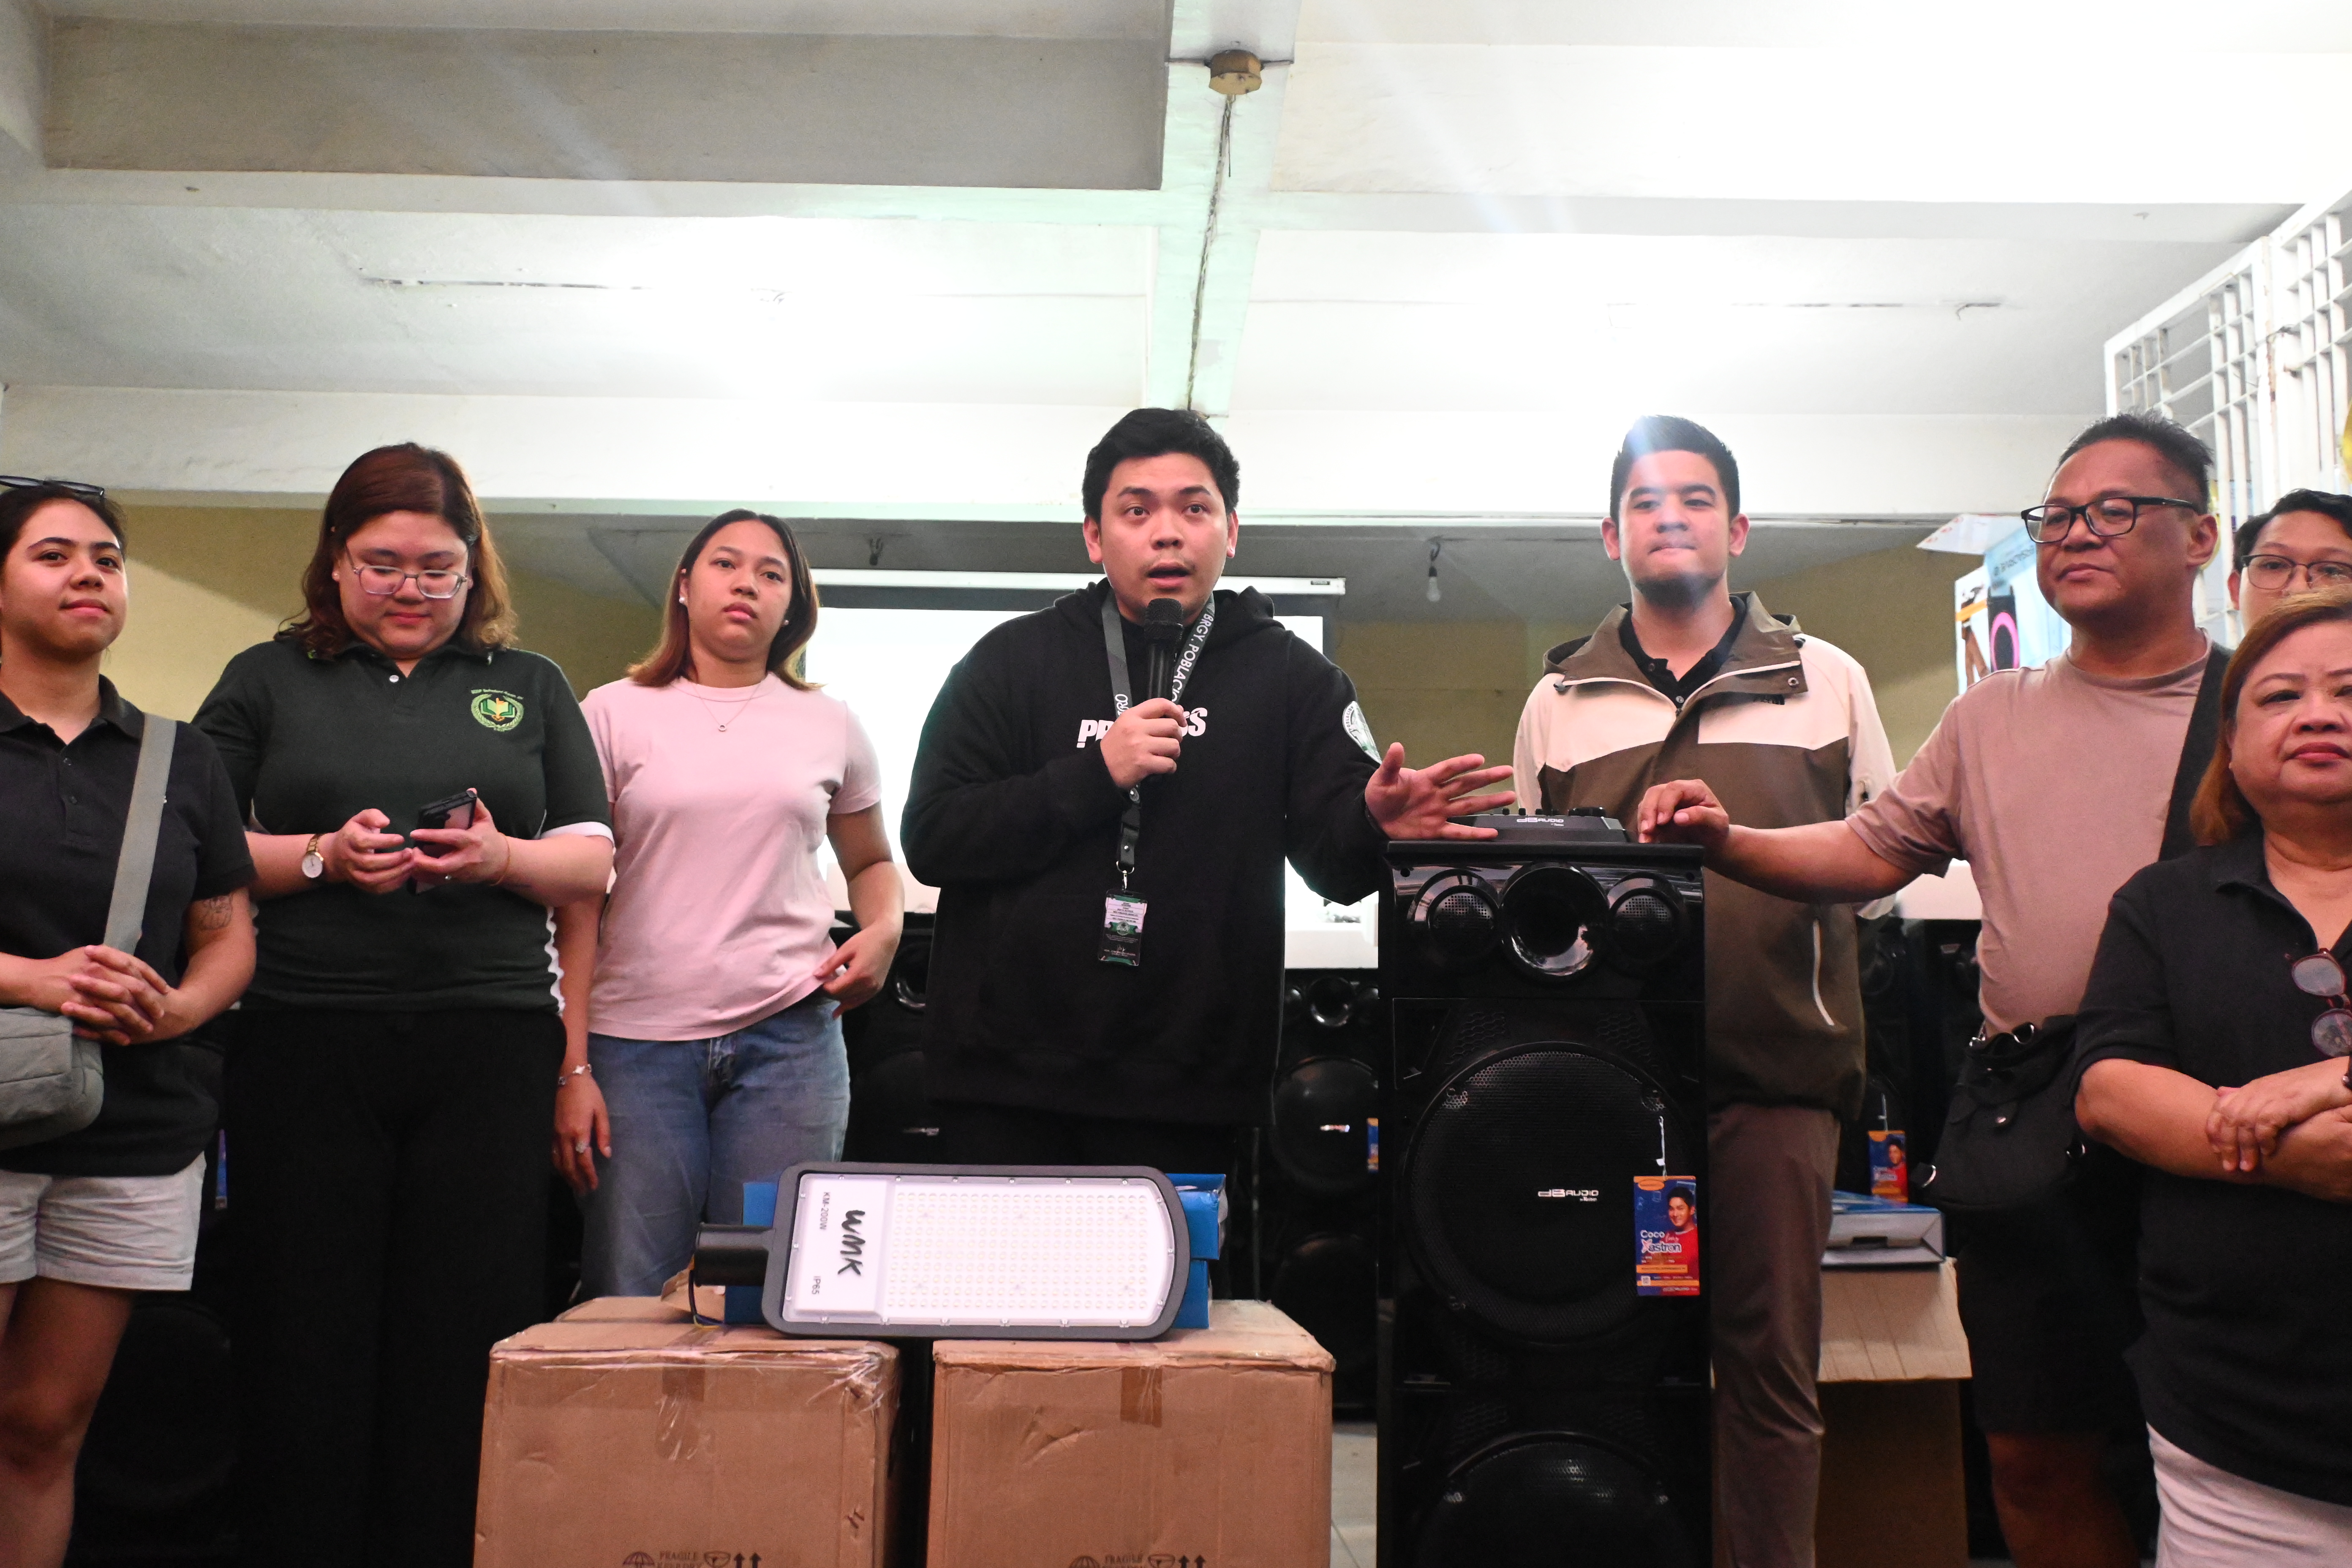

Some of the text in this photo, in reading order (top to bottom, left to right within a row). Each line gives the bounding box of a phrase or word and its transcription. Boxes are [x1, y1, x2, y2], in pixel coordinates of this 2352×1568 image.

[1171, 644, 1200, 702] POBLACIO
[819, 1192, 831, 1230] KM-200W
[838, 1210, 866, 1276] WMK
[1640, 1230, 1665, 1238] Coco
[1641, 1239, 1682, 1253] Xastron
[811, 1276, 821, 1295] IP65
